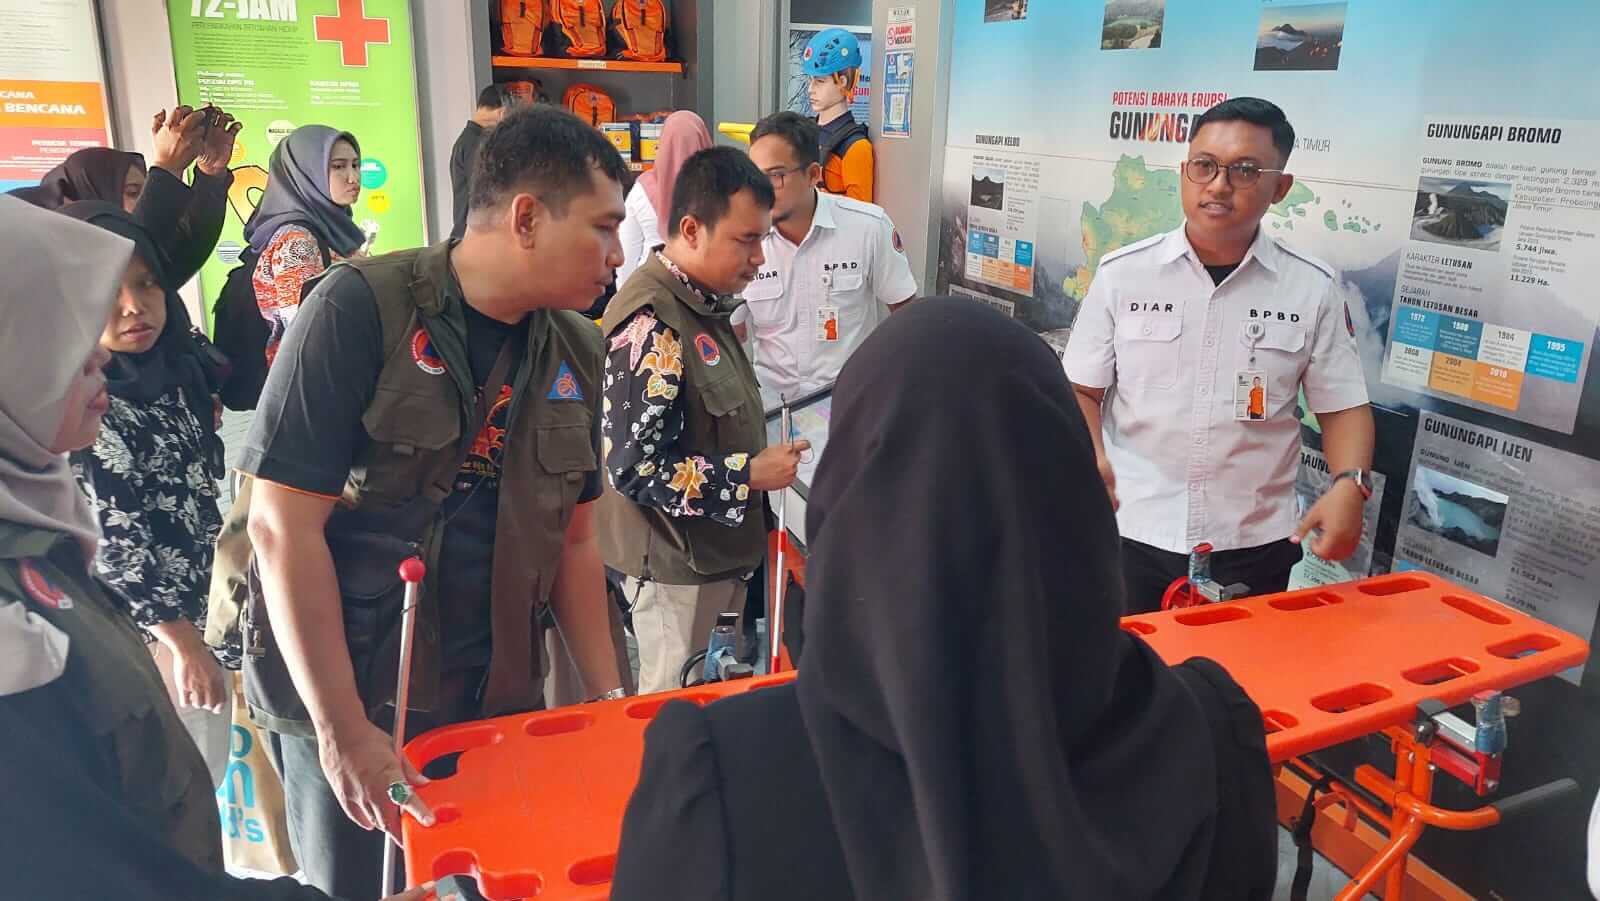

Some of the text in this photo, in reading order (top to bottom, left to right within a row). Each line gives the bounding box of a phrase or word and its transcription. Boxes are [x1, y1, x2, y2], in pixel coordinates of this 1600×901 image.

[1112, 91, 1149, 106] POTENSI
[1151, 92, 1188, 107] BAHAYA
[5, 103, 87, 115] BENCANA
[1427, 122, 1562, 144] GUNUNGAPI BROMO
[1302, 137, 1331, 153] TIMUR
[1406, 252, 1473, 270] KARAKTER LETUSAN
[753, 270, 778, 281] IDAR
[1130, 302, 1174, 313] DIAR
[1249, 309, 1300, 323] BPBD
[1424, 417, 1534, 464] GUNUNGAPI IJEN
